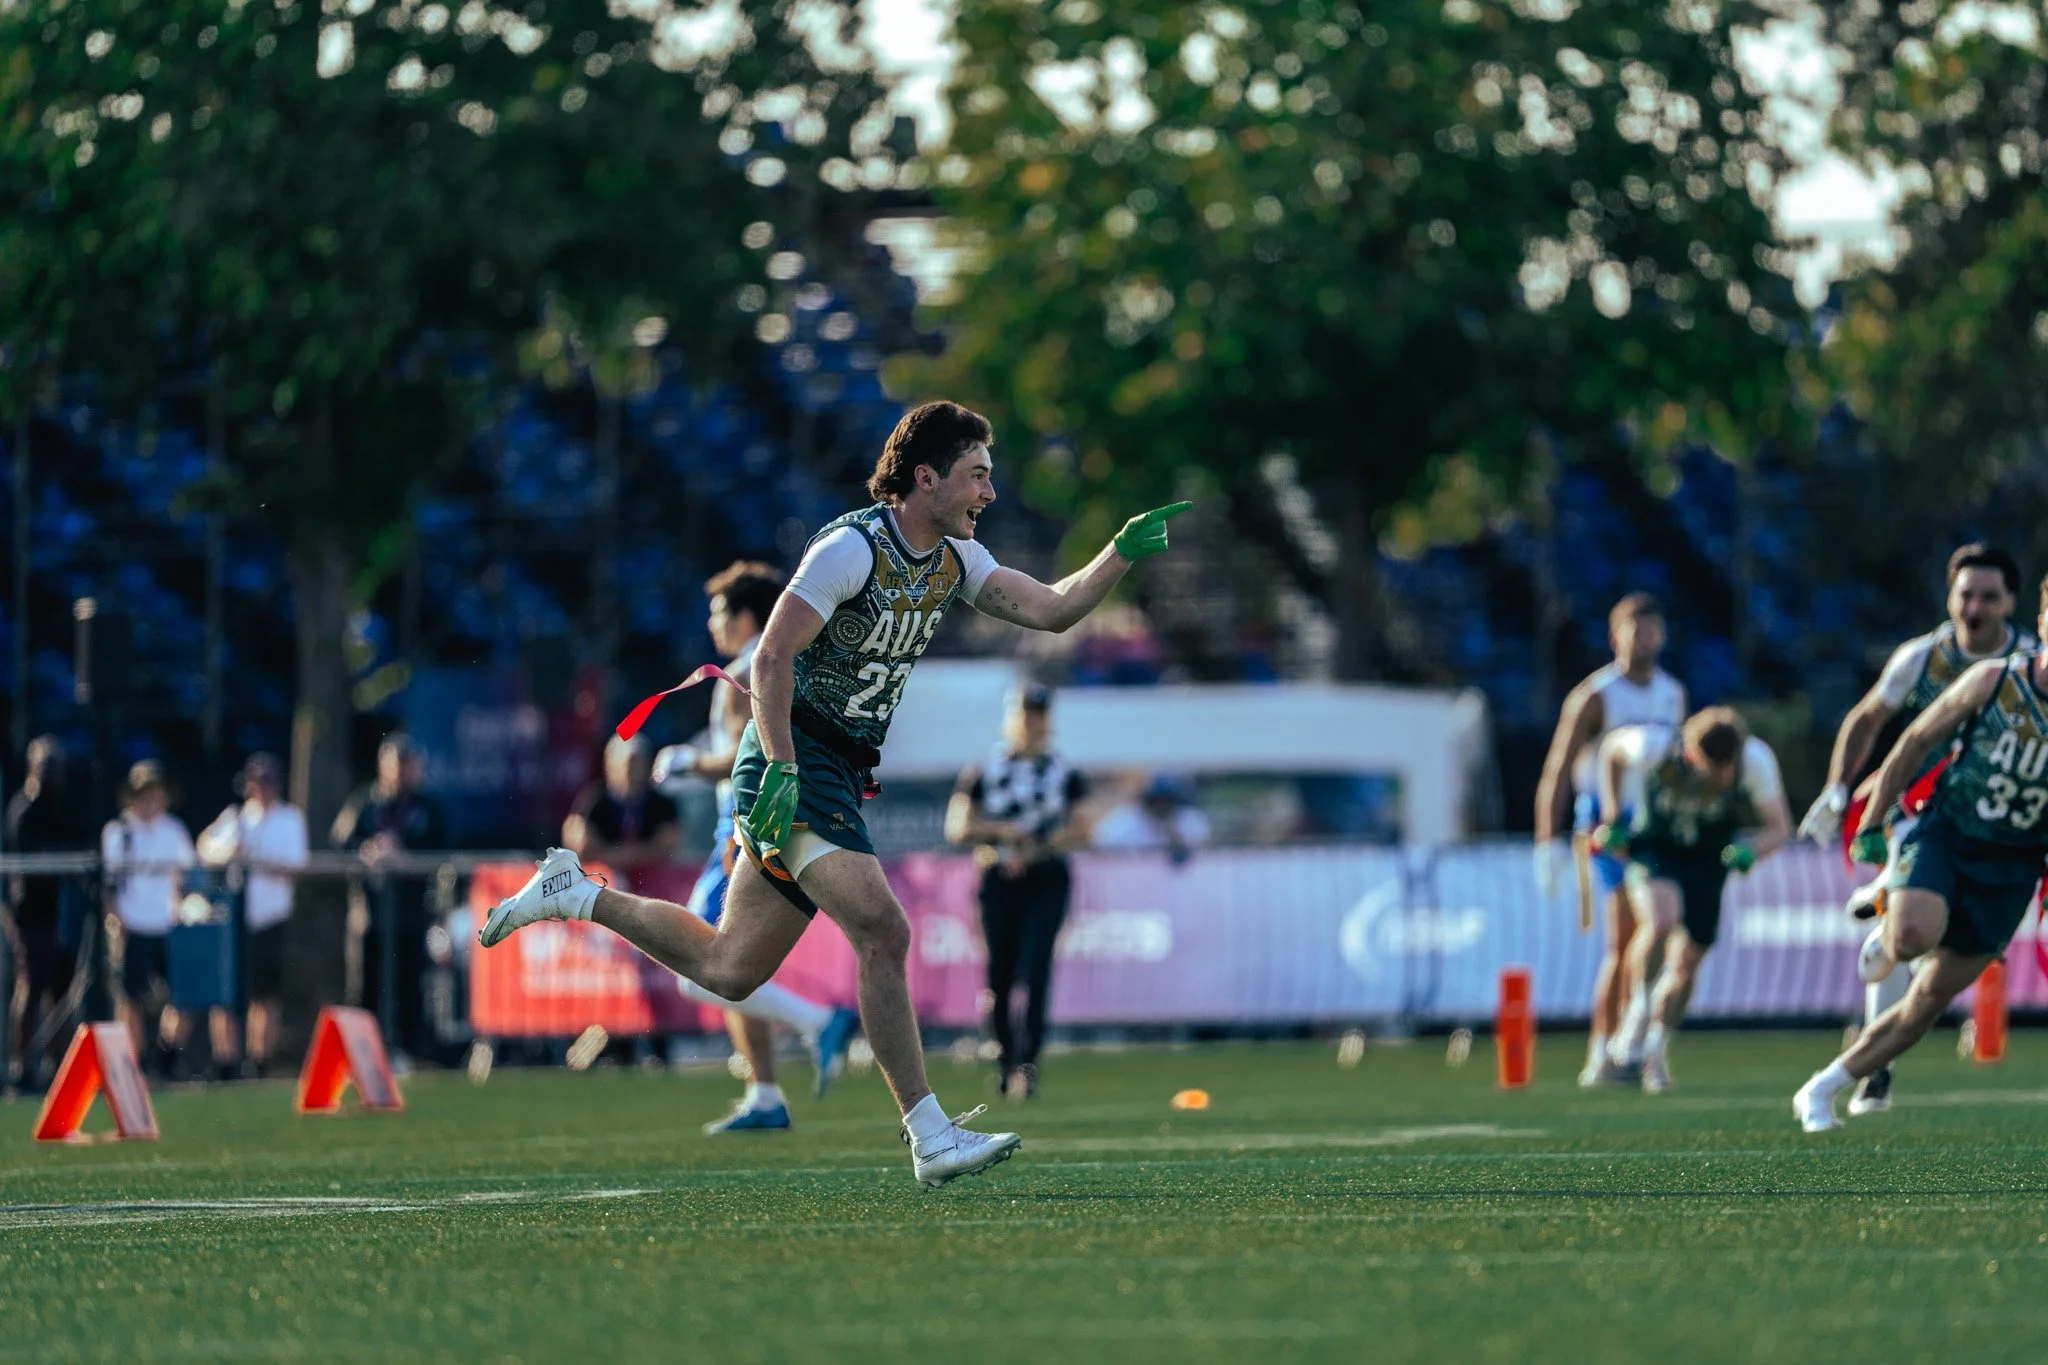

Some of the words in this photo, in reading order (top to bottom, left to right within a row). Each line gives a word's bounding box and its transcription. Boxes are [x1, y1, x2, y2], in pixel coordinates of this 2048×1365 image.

[857, 609, 942, 657] AUS
[844, 662, 912, 721] 23
[1988, 729, 2048, 781] AU
[1976, 773, 2048, 830] 33
[542, 871, 571, 897] NIKE
